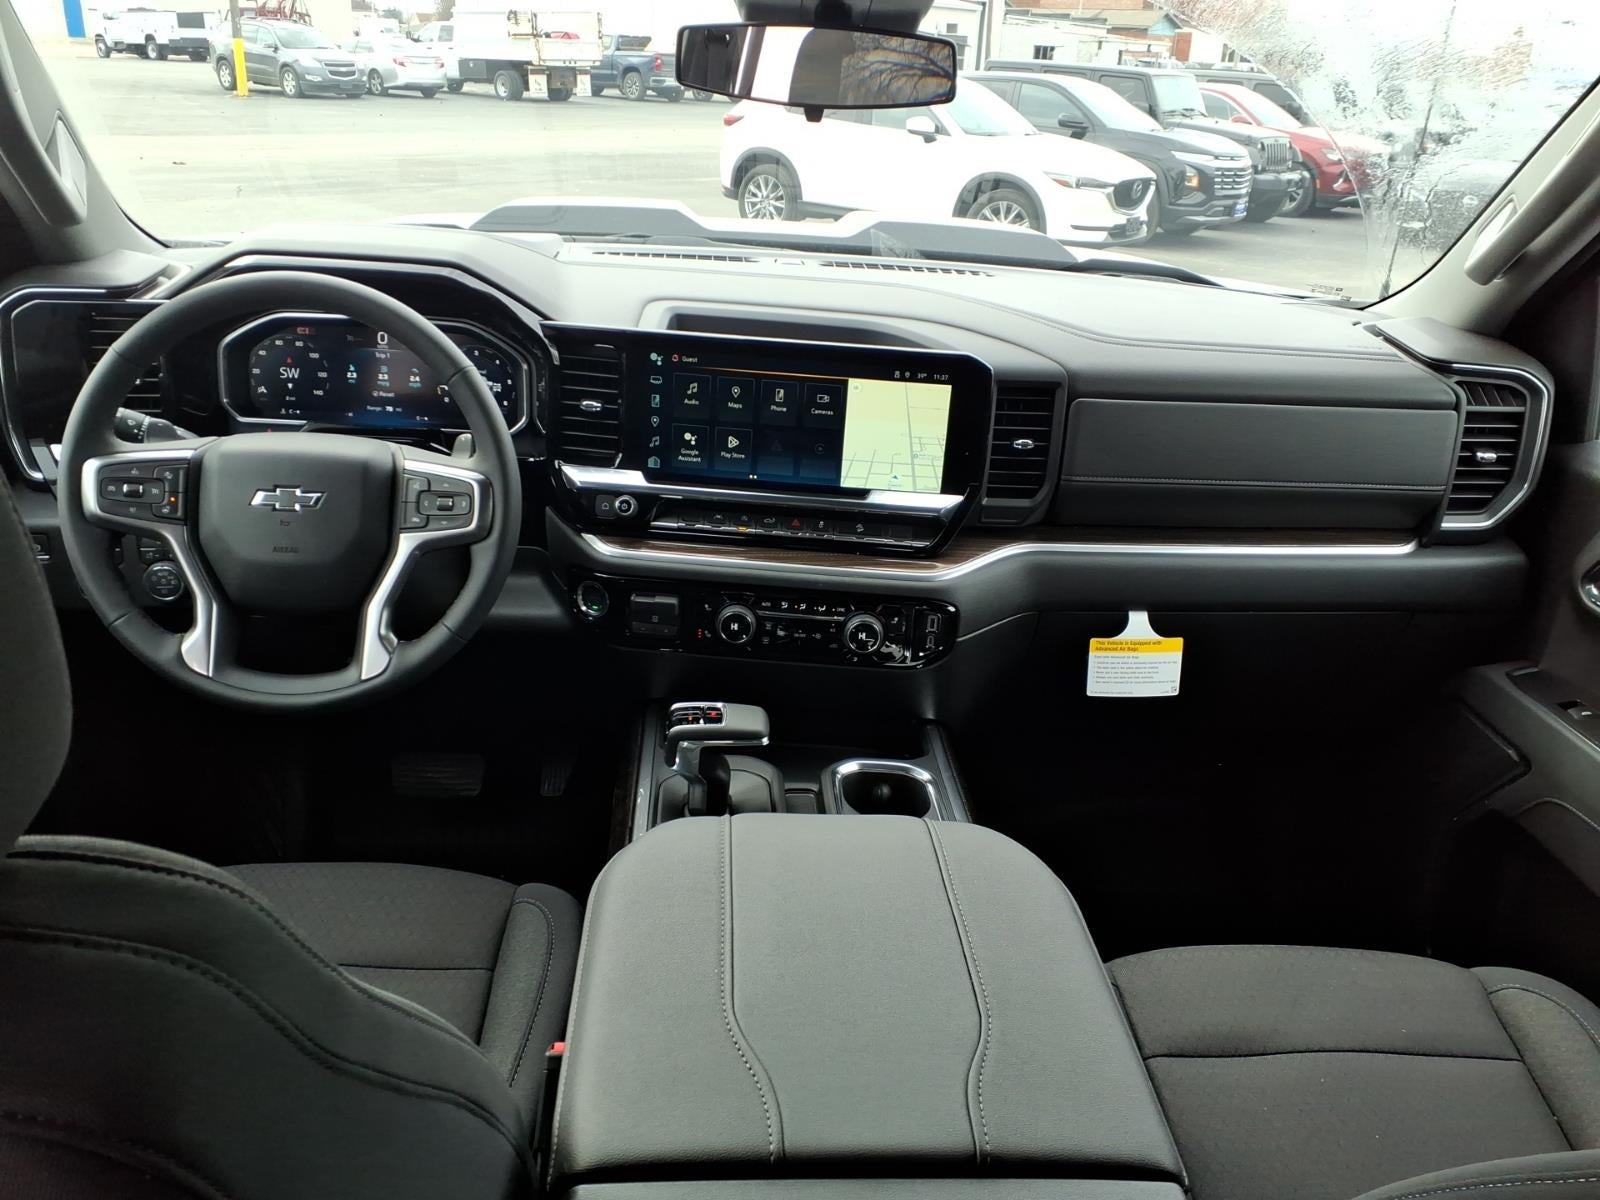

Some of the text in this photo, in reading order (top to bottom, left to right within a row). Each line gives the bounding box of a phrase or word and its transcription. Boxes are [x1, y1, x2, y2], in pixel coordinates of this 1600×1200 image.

[377, 331, 388, 345] 0
[681, 355, 698, 363] Guest
[279, 366, 300, 379] SW
[727, 401, 743, 409] Maps
[770, 404, 787, 412] Phone
[810, 407, 834, 415] Cameras
[680, 448, 699, 456] Google
[720, 451, 731, 459] Play
[678, 455, 702, 463] Assistant
